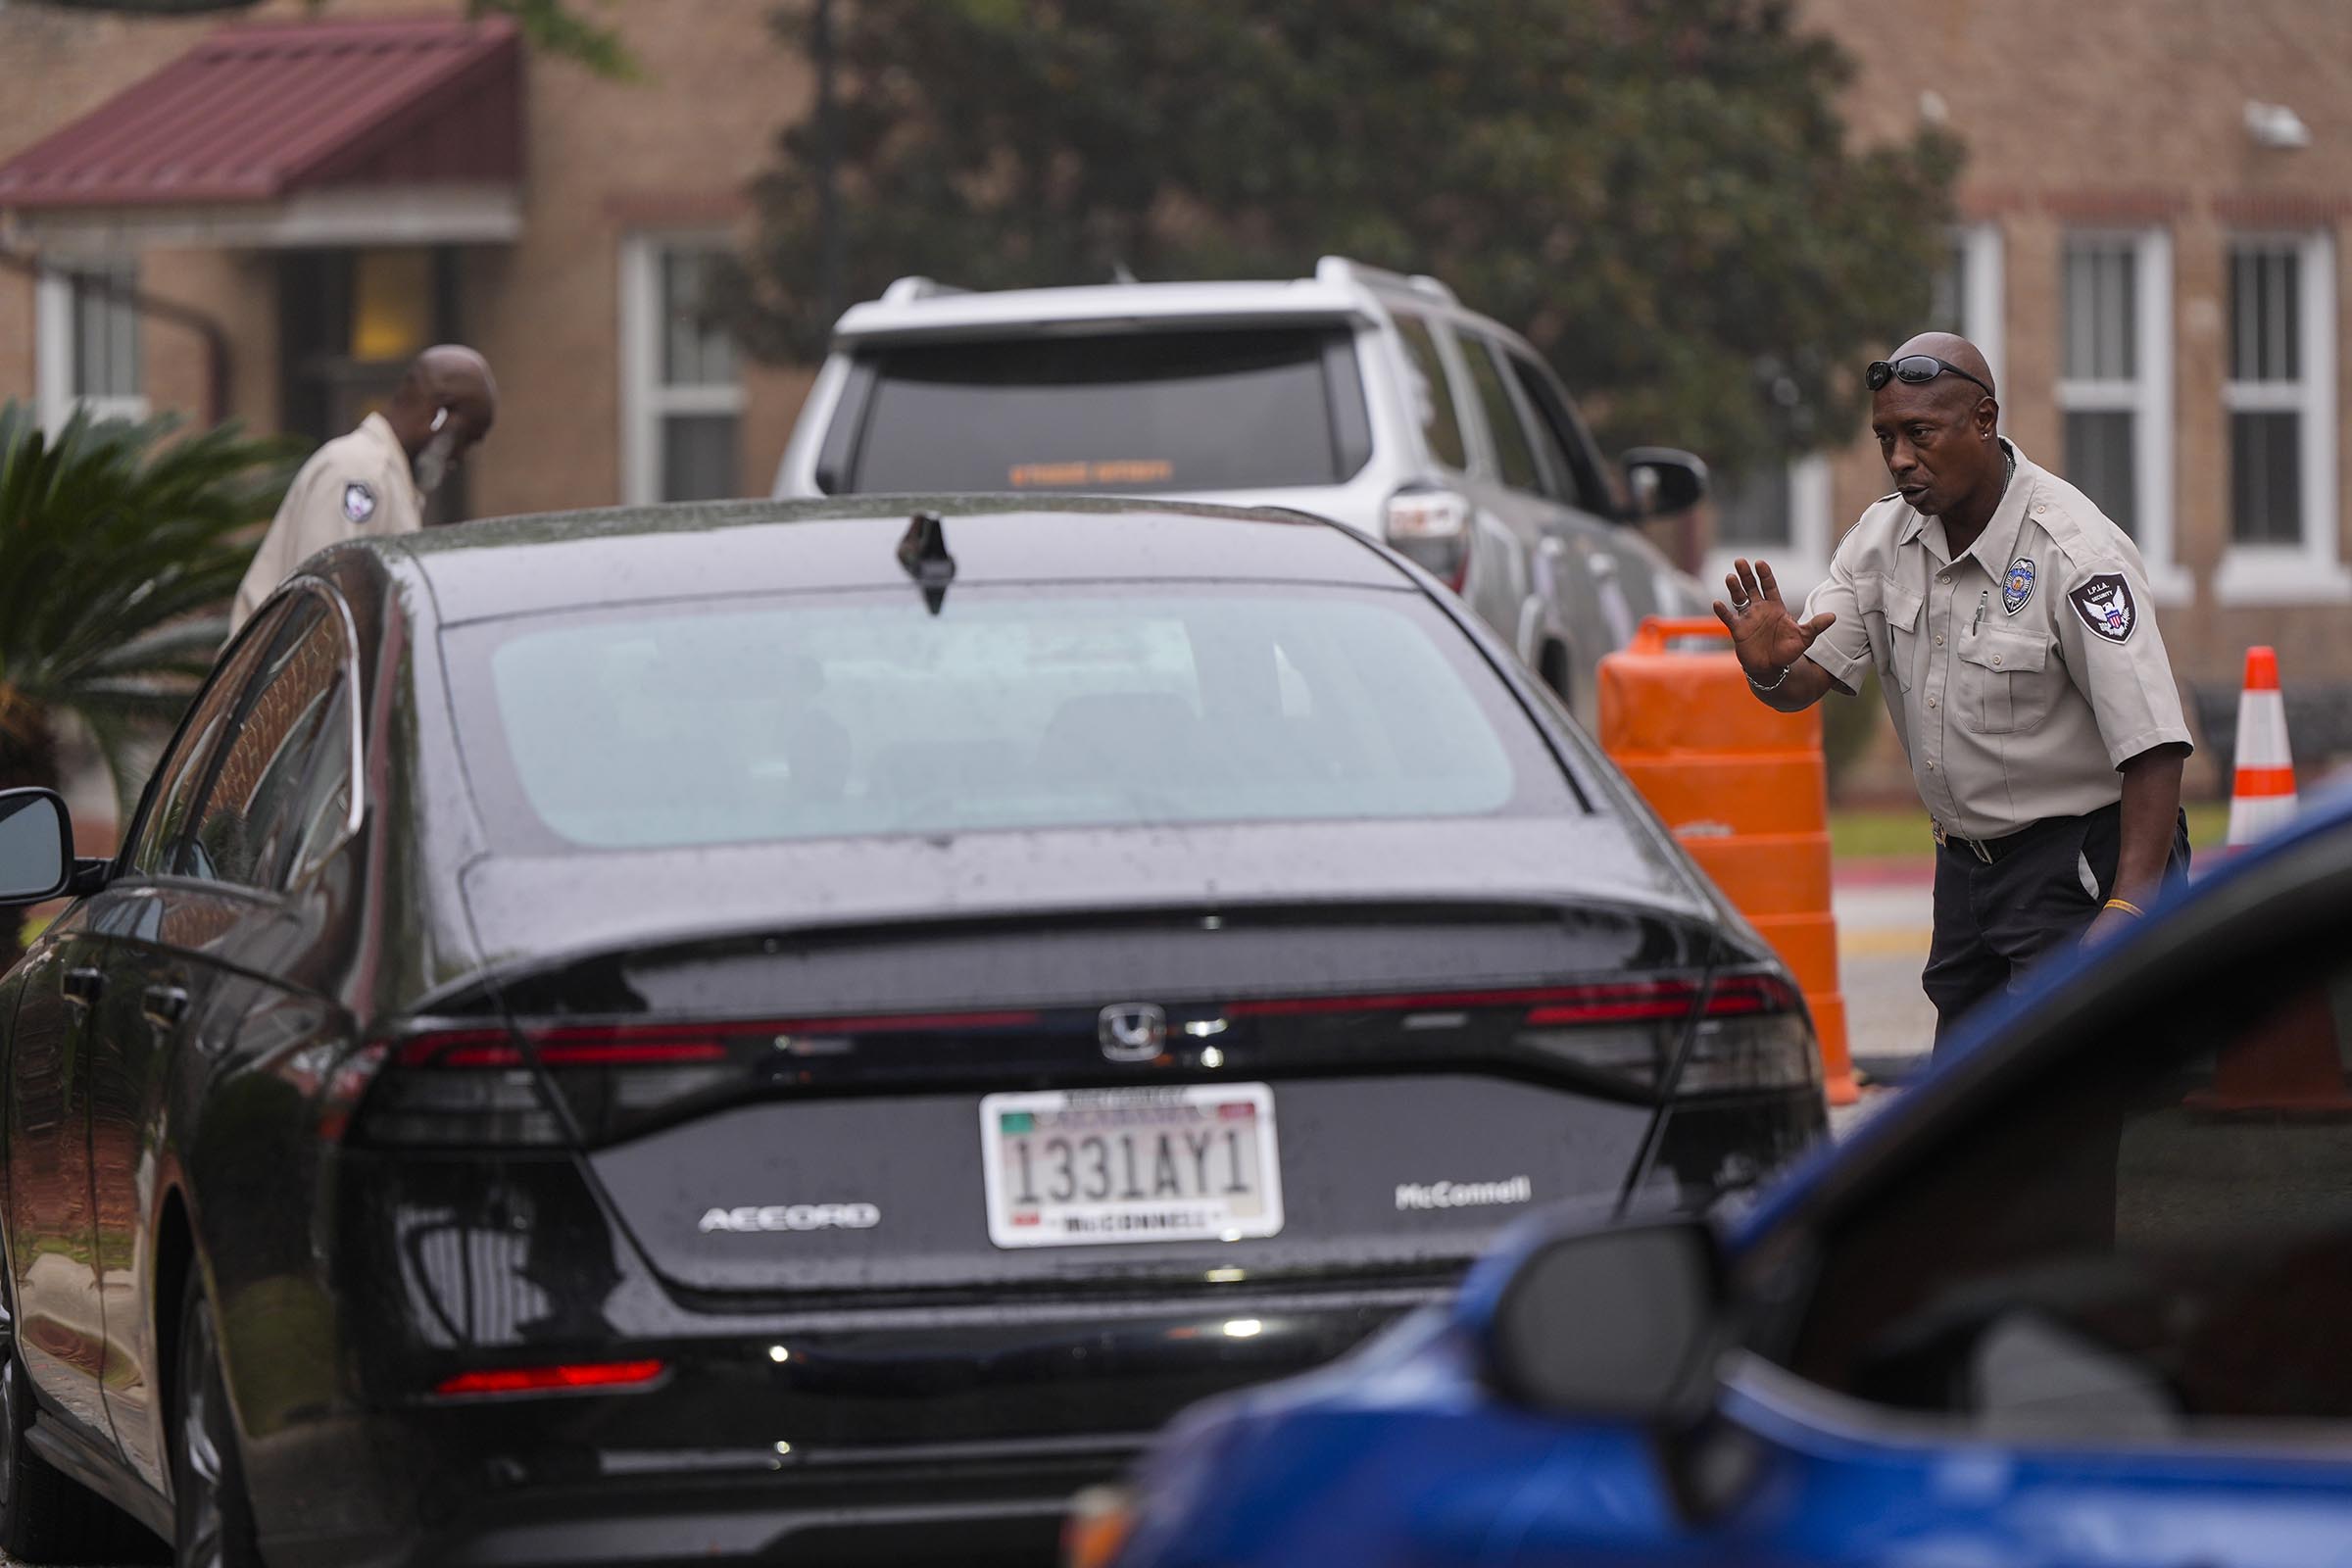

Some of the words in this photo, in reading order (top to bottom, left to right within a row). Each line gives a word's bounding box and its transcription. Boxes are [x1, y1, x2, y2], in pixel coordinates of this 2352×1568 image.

[2091, 590, 2113, 603] SECURITY
[1015, 1130, 1250, 1205] 1331AY1
[1395, 1174, 1532, 1211] McConnell
[697, 1202, 881, 1234] ACCORD
